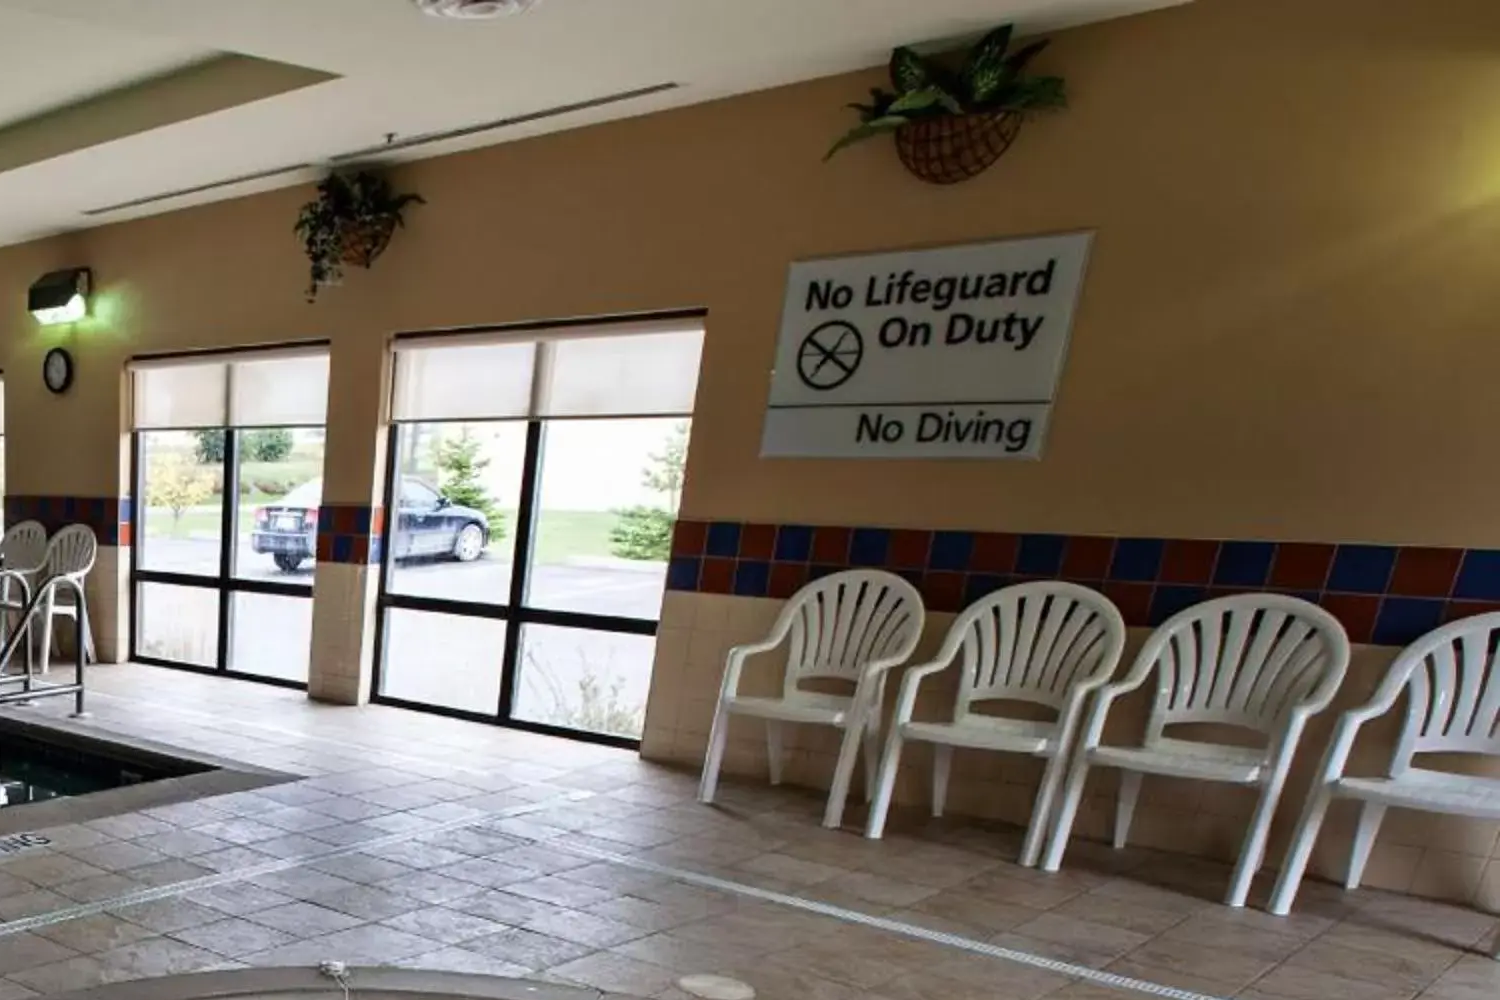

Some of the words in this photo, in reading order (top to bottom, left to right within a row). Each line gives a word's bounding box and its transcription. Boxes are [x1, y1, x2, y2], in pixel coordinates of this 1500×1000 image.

[805, 279, 852, 312] No
[864, 258, 1056, 311] Lifeguard
[878, 316, 931, 349] On
[945, 311, 1044, 351] Duty
[855, 413, 904, 443] No
[916, 410, 1032, 452] Diving
